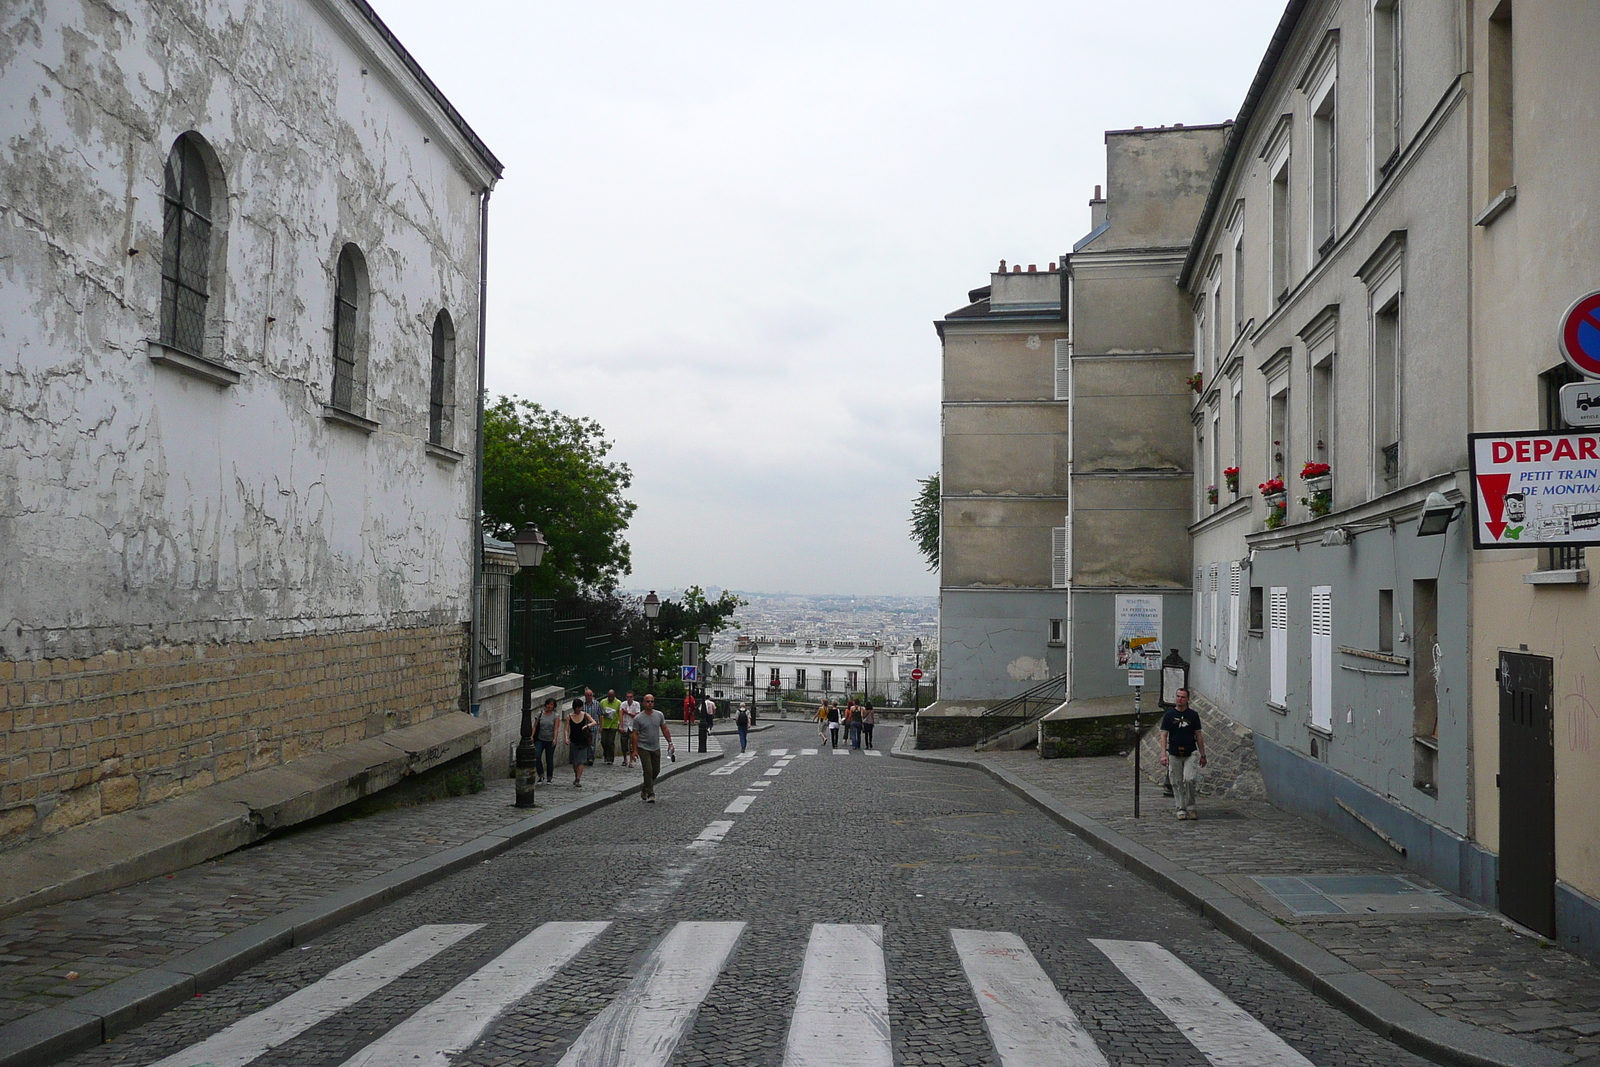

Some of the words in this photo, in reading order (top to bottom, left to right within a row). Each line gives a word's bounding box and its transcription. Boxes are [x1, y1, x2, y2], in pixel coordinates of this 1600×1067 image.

[1491, 437, 1600, 464] DEPAR
[1520, 470, 1553, 481] PETIT
[1558, 469, 1597, 480] TRAIN
[1521, 486, 1538, 496] DE
